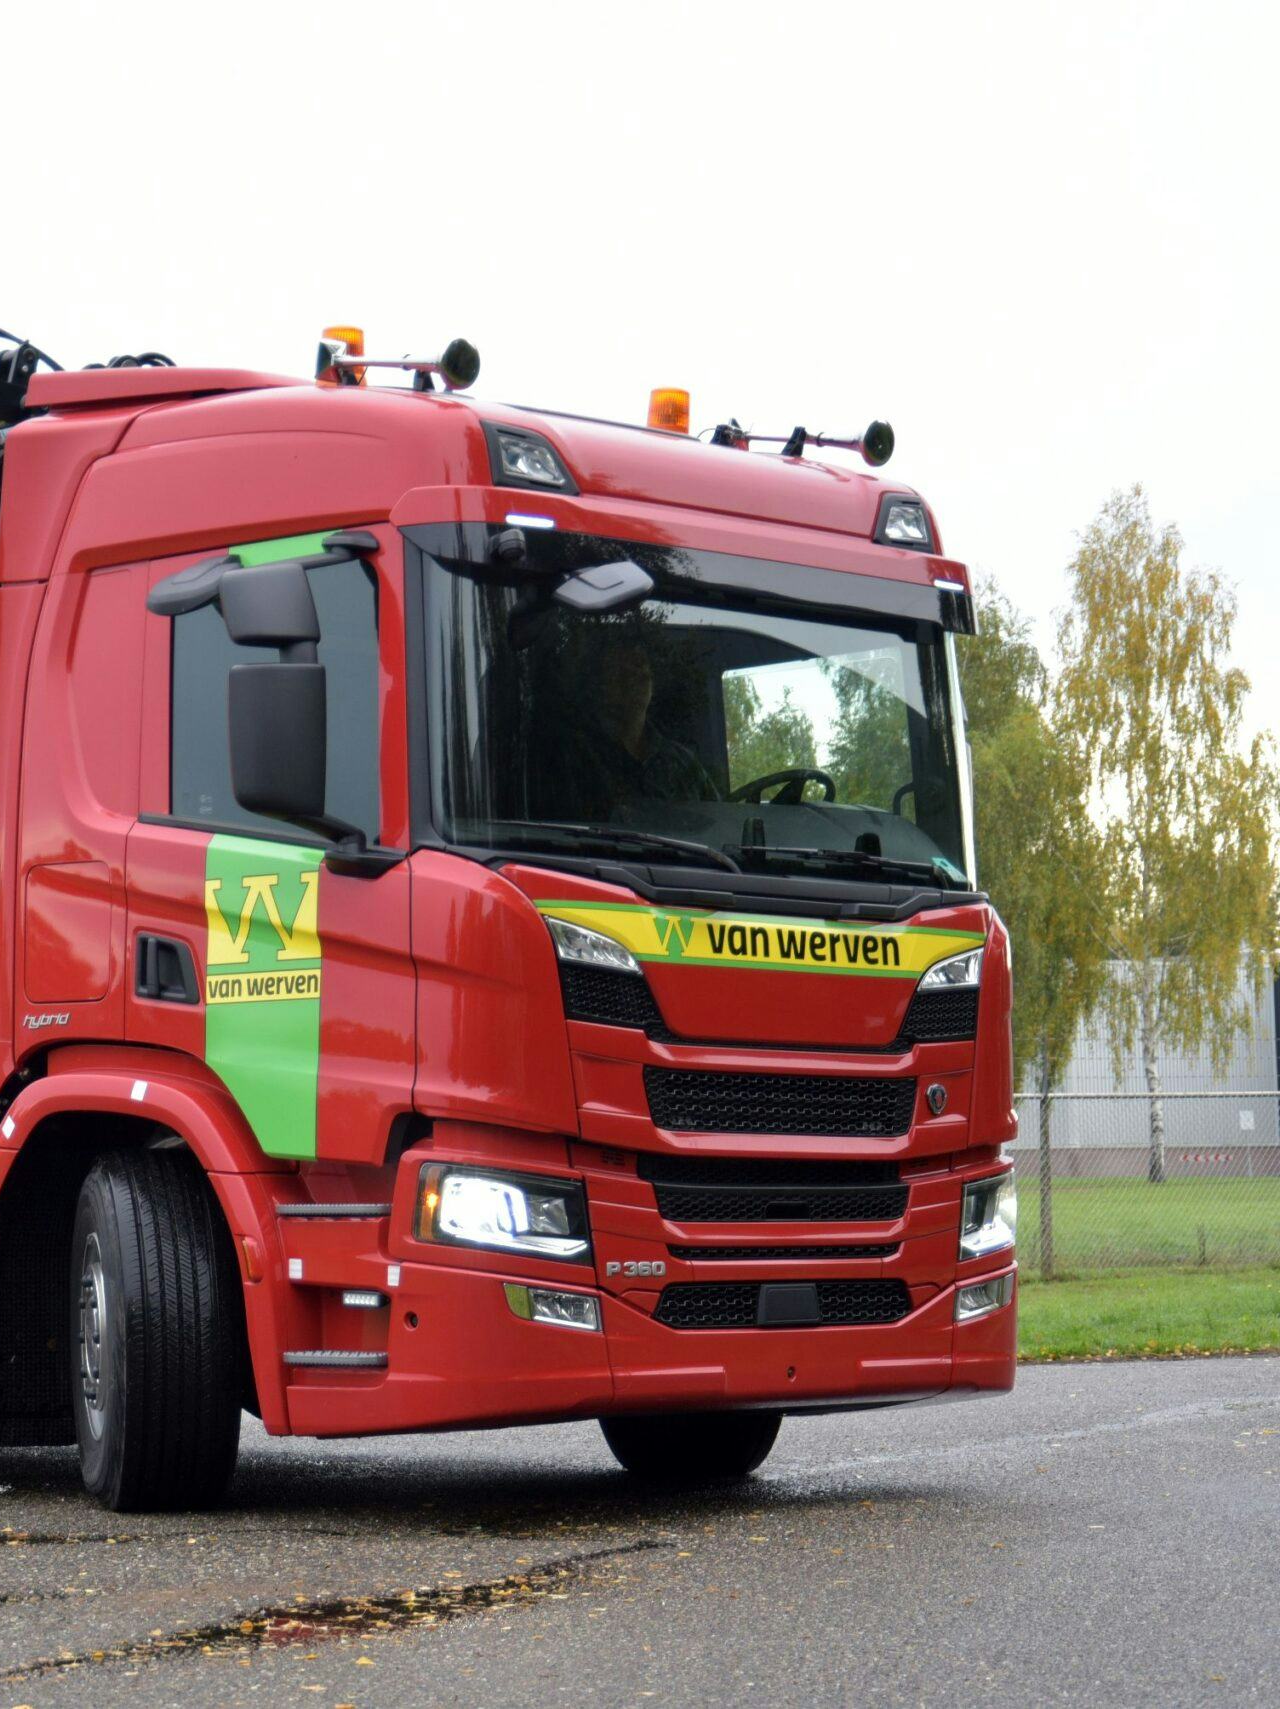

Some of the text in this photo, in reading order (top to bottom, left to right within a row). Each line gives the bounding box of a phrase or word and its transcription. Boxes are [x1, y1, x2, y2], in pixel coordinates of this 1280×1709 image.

[706, 923, 770, 958] van
[776, 928, 901, 966] werven
[208, 973, 319, 999] van werven
[22, 1012, 70, 1029] hybrid
[606, 1260, 666, 1277] P 360
